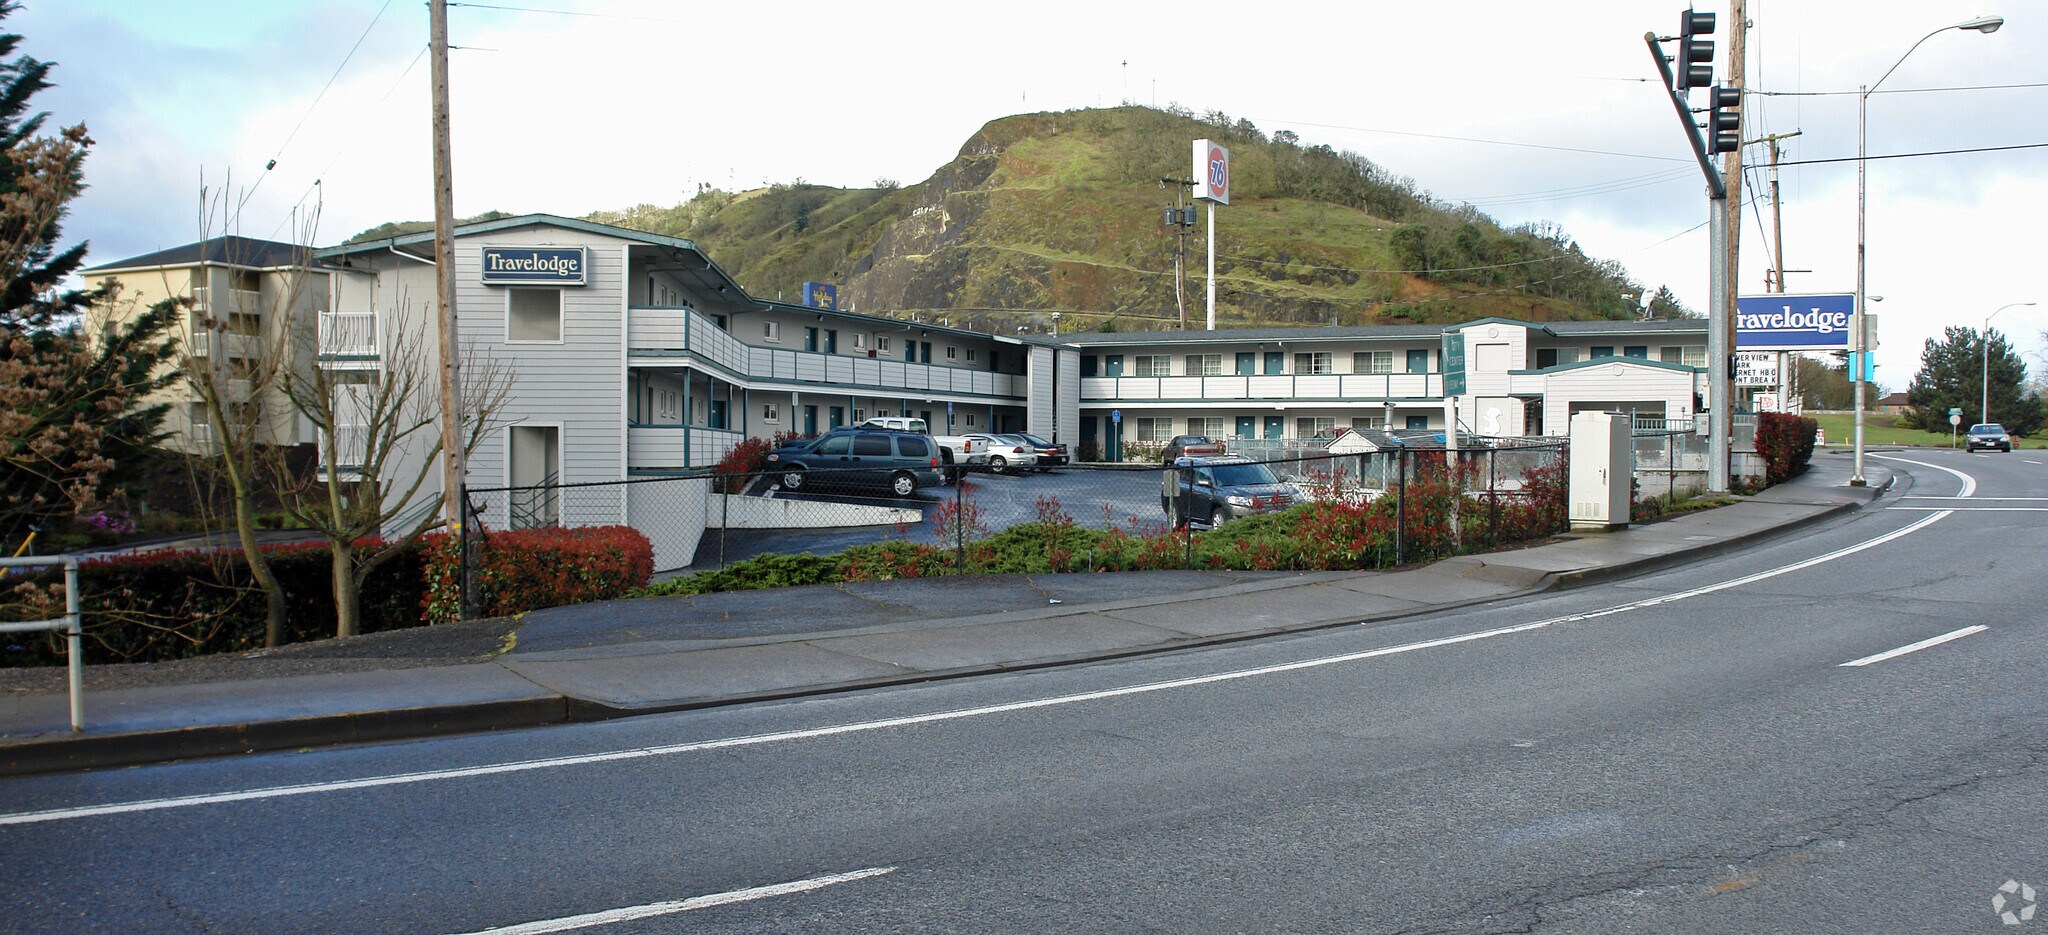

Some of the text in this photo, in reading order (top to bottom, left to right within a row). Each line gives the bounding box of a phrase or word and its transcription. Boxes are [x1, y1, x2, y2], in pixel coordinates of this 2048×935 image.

[1211, 160, 1224, 188] 76
[487, 253, 578, 276] Travelodge
[1737, 306, 1847, 334] ravelodge
